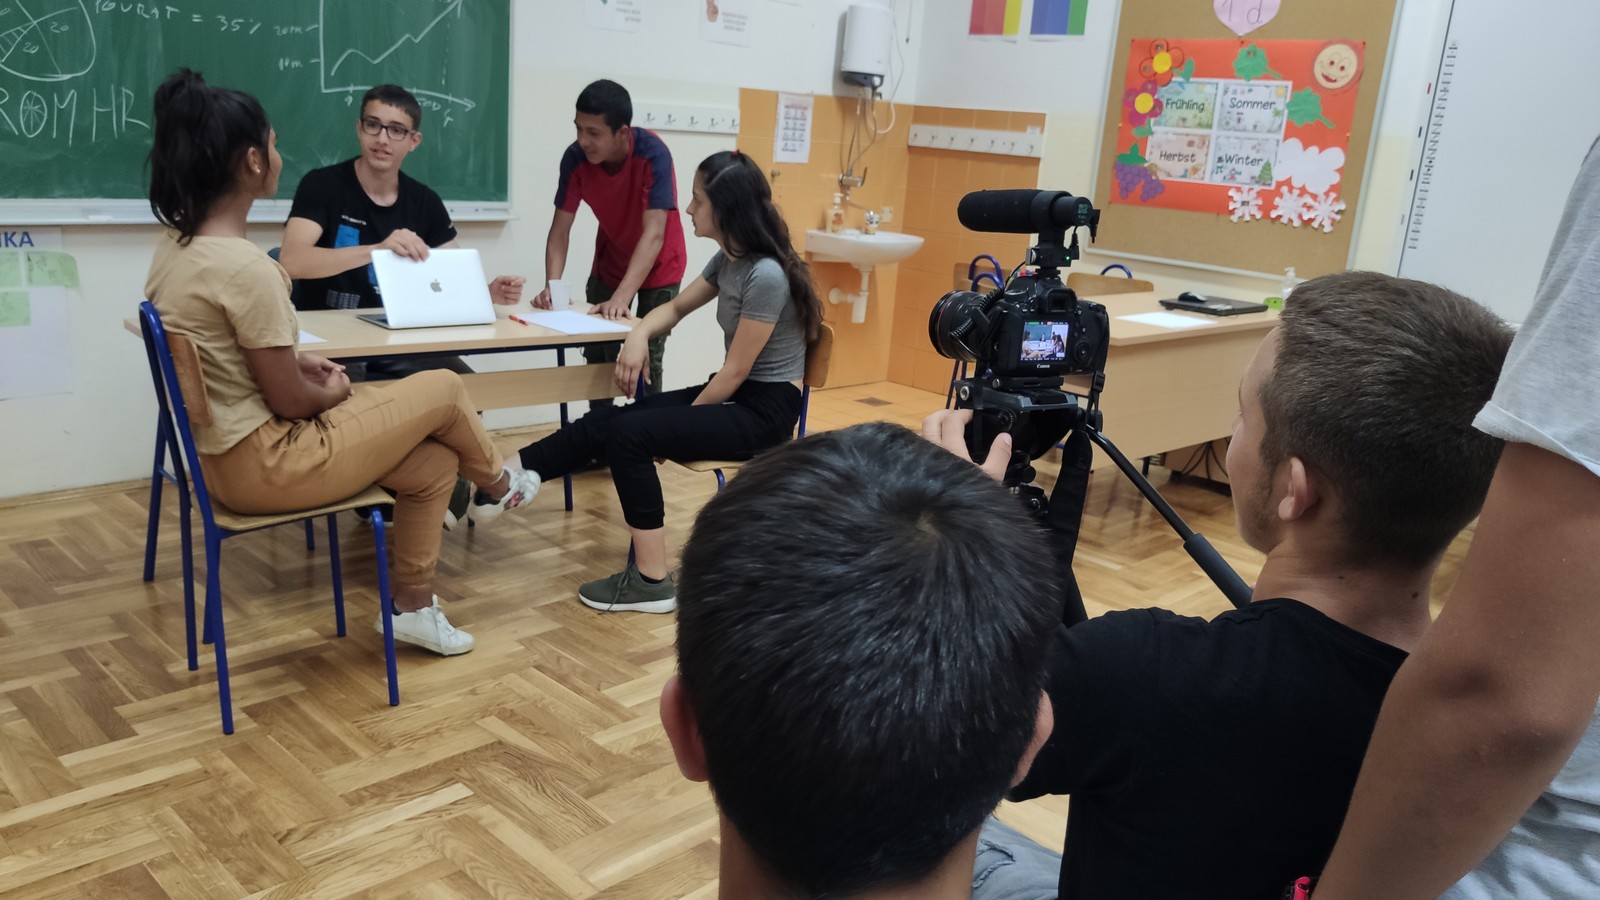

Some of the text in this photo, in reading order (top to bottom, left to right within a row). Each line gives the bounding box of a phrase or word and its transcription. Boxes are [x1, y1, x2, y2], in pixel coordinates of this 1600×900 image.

[50, 21, 69, 33] 20
[22, 41, 39, 54] 20
[1165, 97, 1205, 113] Frühling
[1229, 97, 1276, 110] Sommer
[1159, 150, 1196, 163] Herbst
[1225, 153, 1263, 166] Winter
